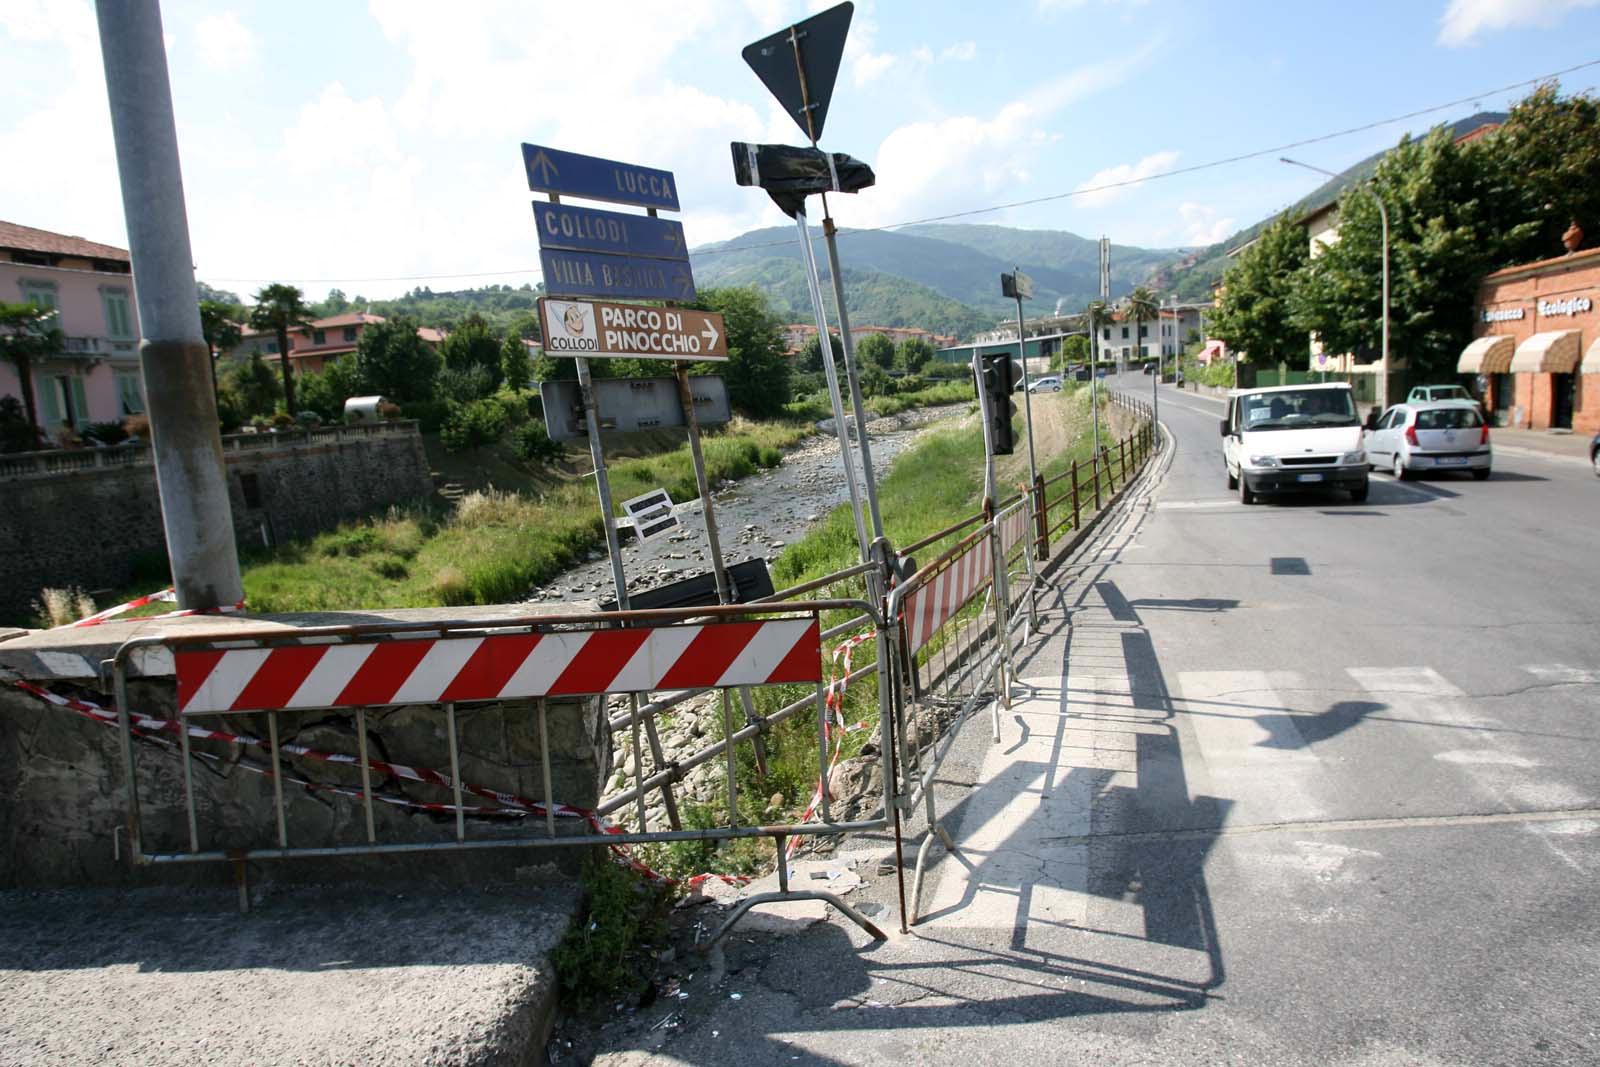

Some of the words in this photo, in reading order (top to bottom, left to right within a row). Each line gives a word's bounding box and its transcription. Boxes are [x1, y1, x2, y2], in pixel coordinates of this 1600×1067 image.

[615, 168, 673, 199] LUCCA
[545, 211, 629, 243] COLLODI
[552, 258, 595, 287] VILLA
[601, 307, 662, 330] PARCO
[666, 312, 683, 332] DI
[1538, 297, 1592, 317] Ecologico
[550, 336, 599, 351] COLLODI
[605, 330, 701, 353] PINOCCHIO
